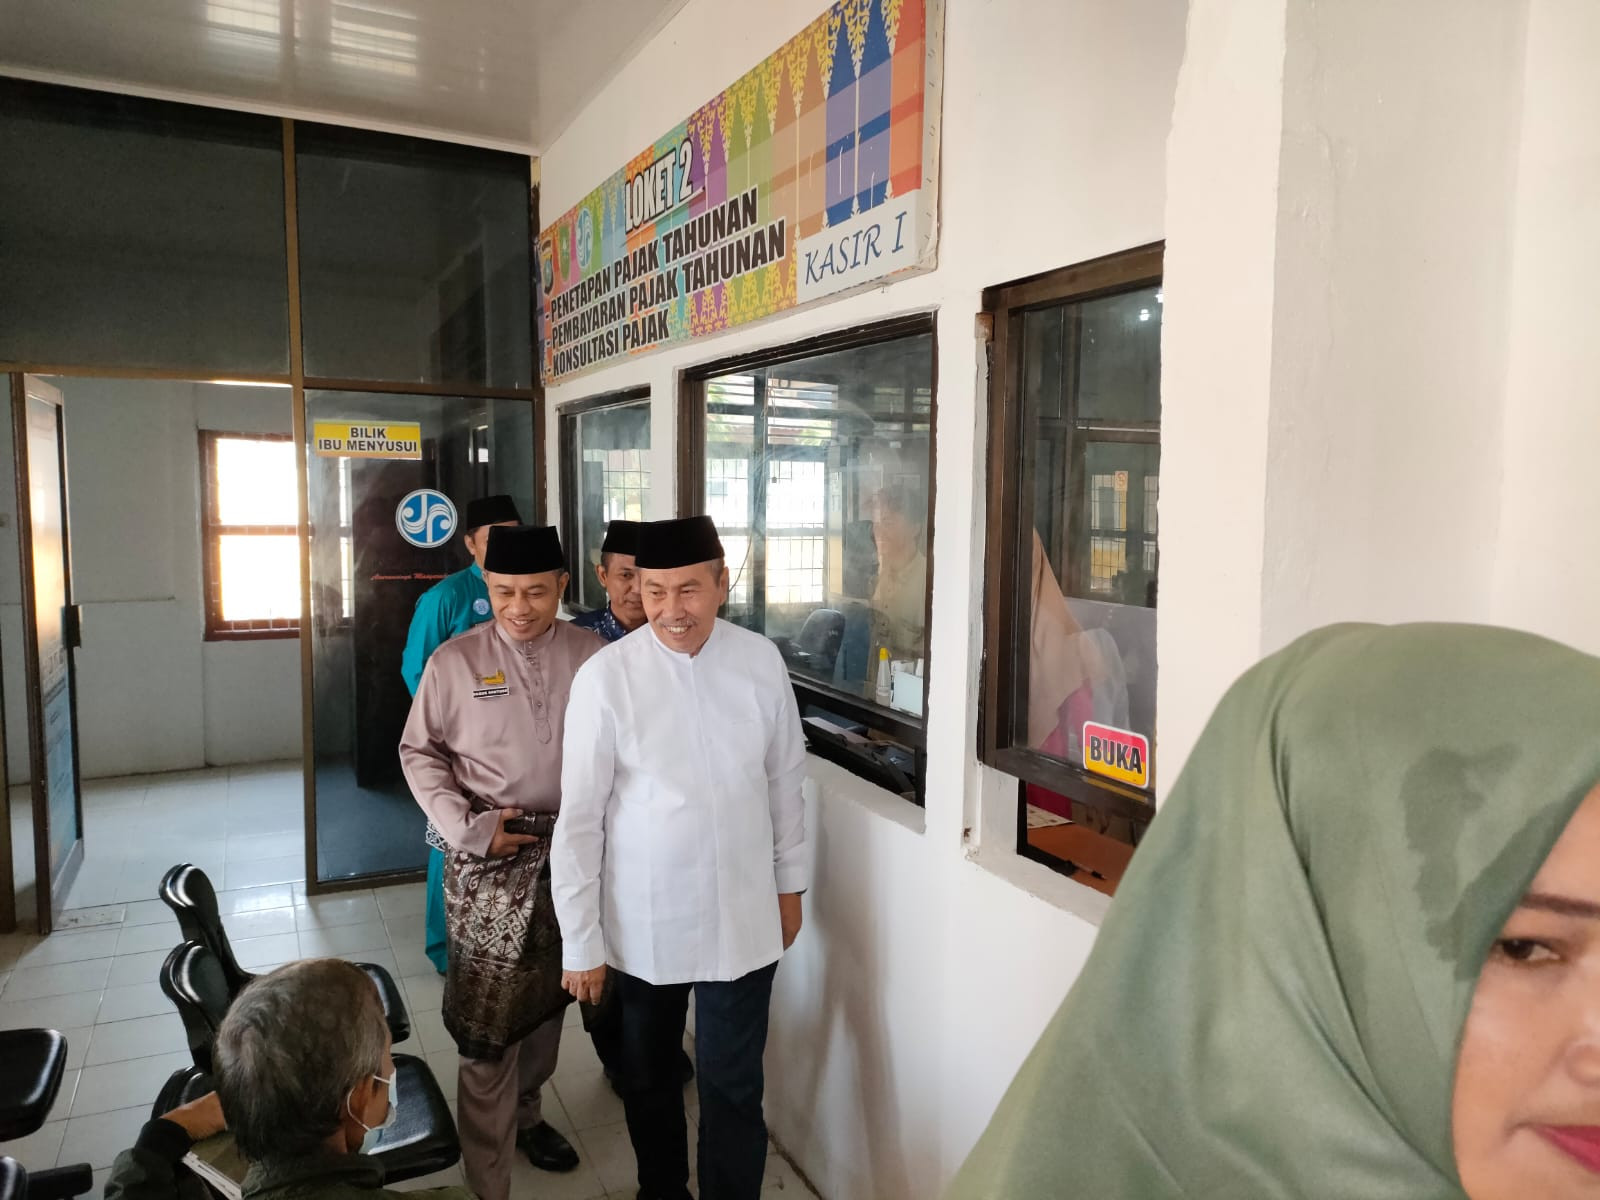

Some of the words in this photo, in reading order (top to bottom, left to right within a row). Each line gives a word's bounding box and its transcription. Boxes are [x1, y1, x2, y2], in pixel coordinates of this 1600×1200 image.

[624, 147, 677, 235] LOKET
[679, 137, 693, 202] 2
[551, 265, 611, 323] PENETAPAN
[614, 239, 660, 288] PAJAK
[662, 187, 758, 265] TAHUNAN
[552, 291, 626, 349] PEMBAYARAN
[629, 268, 679, 315] PAJAK
[682, 219, 786, 294] TAHUNAN
[805, 223, 882, 285] KASIR
[553, 327, 619, 377] KONSULTASI
[622, 309, 670, 352] PAJAK
[318, 439, 342, 450] IBU
[346, 440, 417, 452] MENYUSUI
[350, 427, 387, 439] BILIK
[1090, 736, 1142, 775] BUKA
